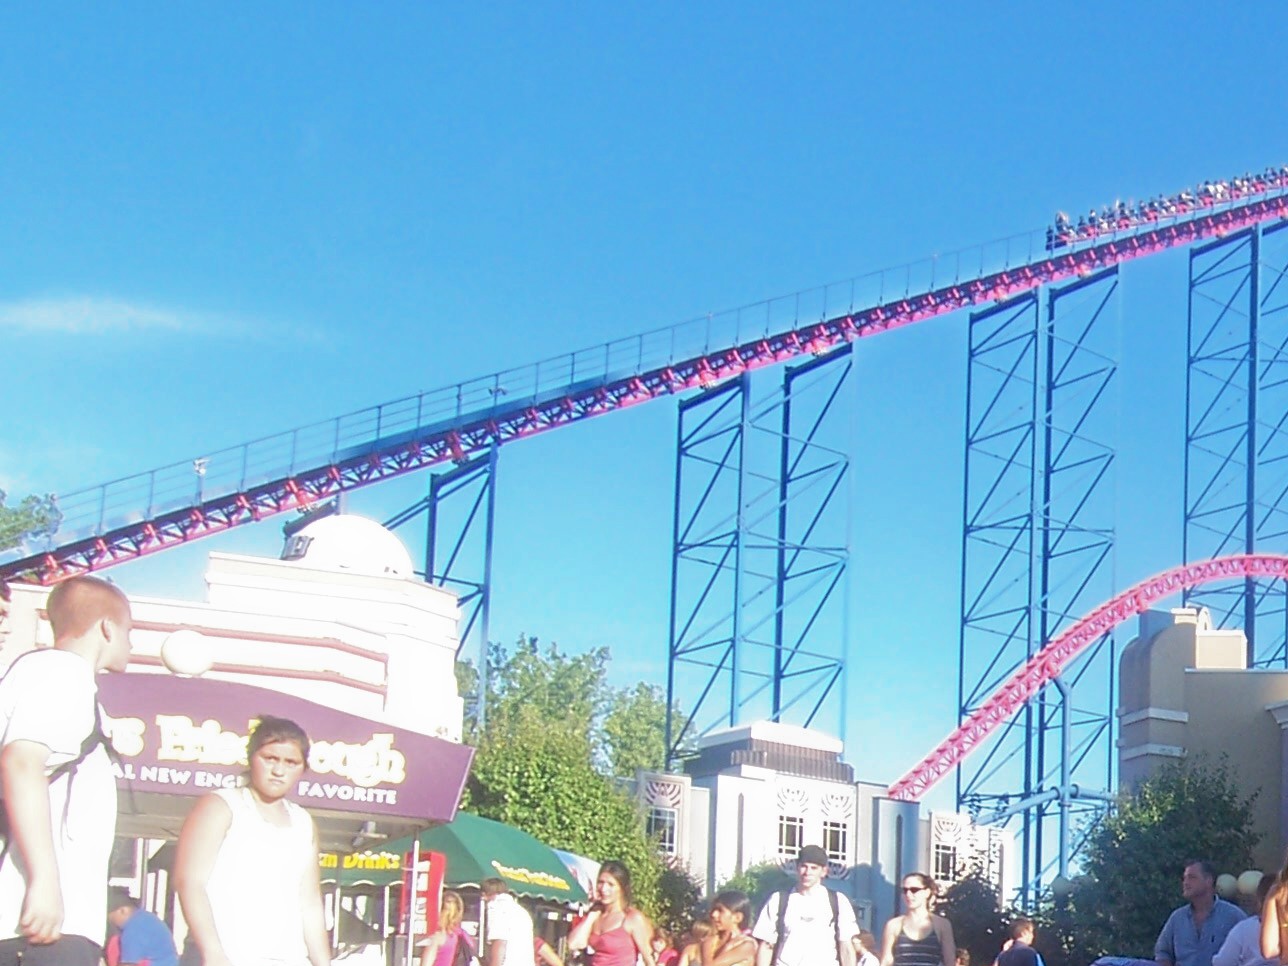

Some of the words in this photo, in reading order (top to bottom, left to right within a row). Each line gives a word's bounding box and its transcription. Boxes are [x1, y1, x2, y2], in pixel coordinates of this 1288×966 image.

[307, 733, 406, 787] ough
[140, 765, 191, 785] NEW
[298, 780, 397, 804] FAVORITE
[343, 850, 400, 869] Drinks
